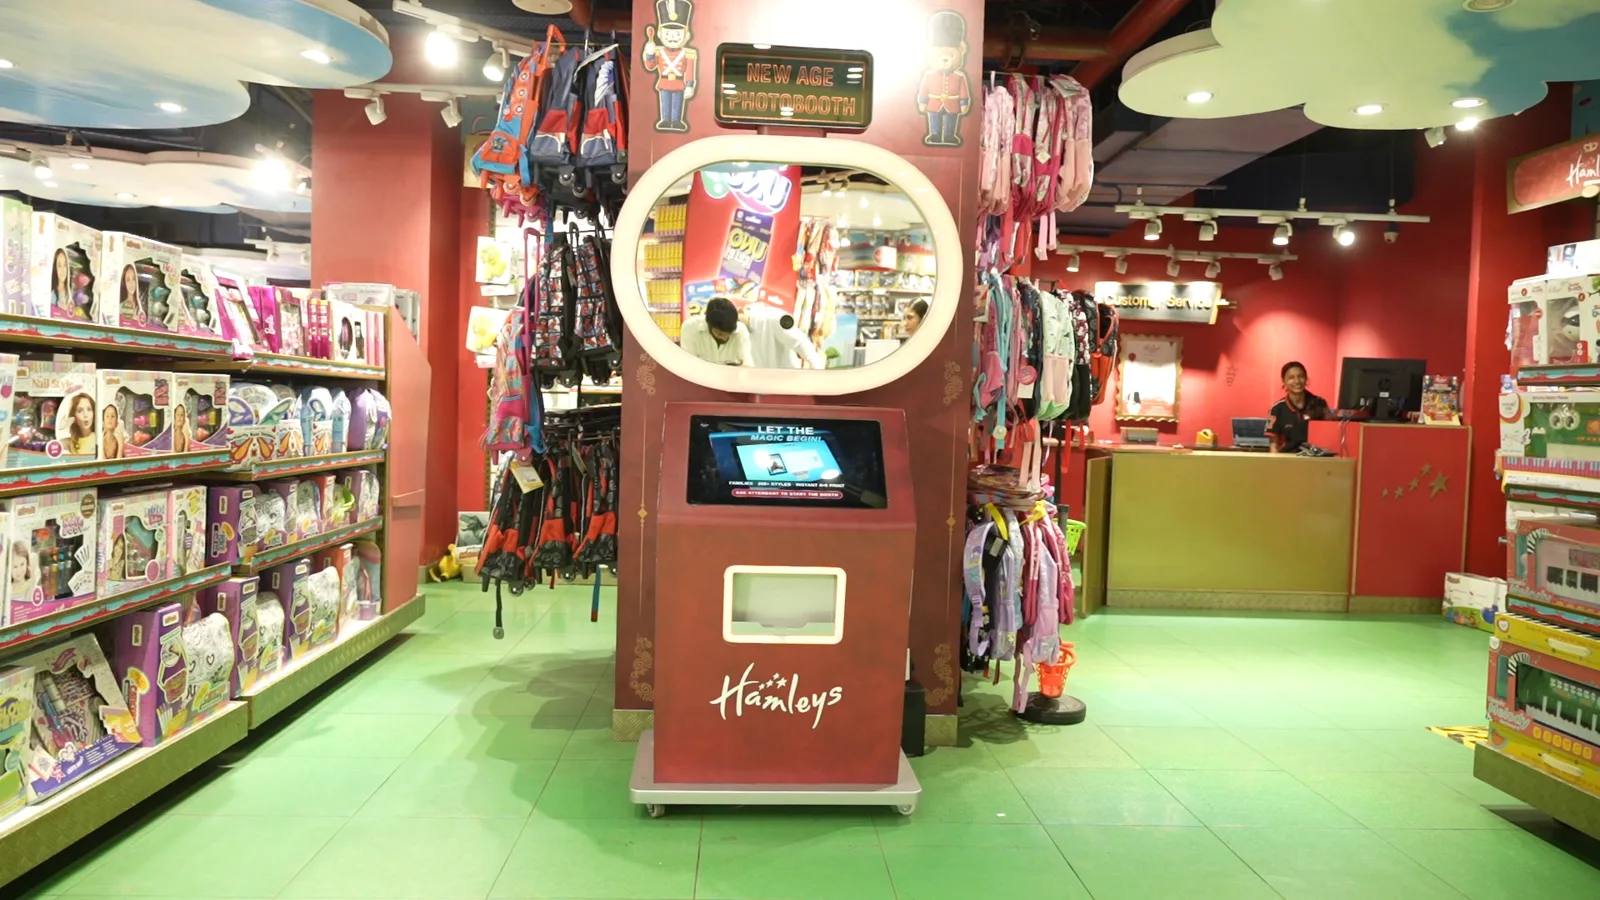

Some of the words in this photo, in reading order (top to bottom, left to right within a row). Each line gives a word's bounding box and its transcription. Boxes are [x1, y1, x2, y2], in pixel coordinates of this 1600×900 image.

[747, 62, 792, 85] NEW
[796, 65, 835, 87] AGE
[729, 91, 856, 117] PHOTOBOOTH
[1105, 294, 1159, 310] Custom
[32, 379, 50, 388] Nail
[750, 434, 785, 442] MAGIC
[786, 434, 822, 442] BEGIN!
[758, 425, 783, 434] LET
[788, 426, 814, 435] THE
[709, 662, 843, 729] Hamleys
